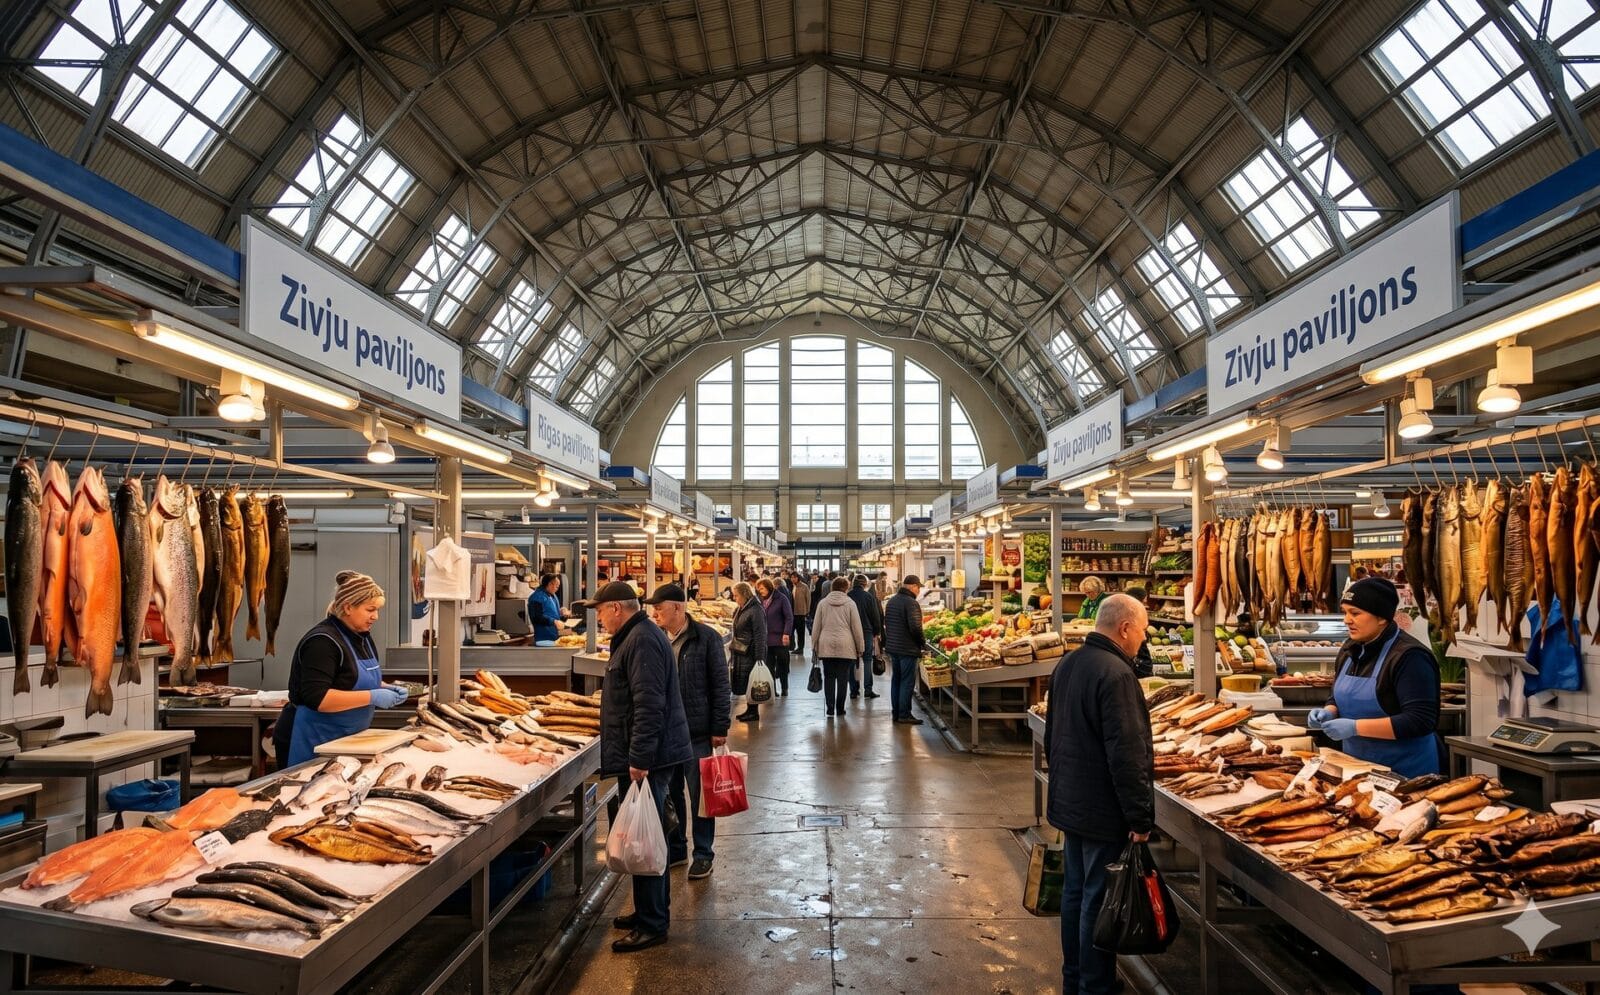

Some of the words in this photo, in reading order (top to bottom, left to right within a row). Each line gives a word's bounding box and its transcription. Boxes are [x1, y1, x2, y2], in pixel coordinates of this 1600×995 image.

[280, 274, 348, 352] Zivju
[356, 326, 445, 395] paviljons
[1225, 335, 1276, 388] Zivju
[1283, 265, 1417, 372] paviljons
[562, 433, 594, 465] paviljons
[1053, 437, 1071, 466] Zivju
[1072, 421, 1112, 461] paviljons
